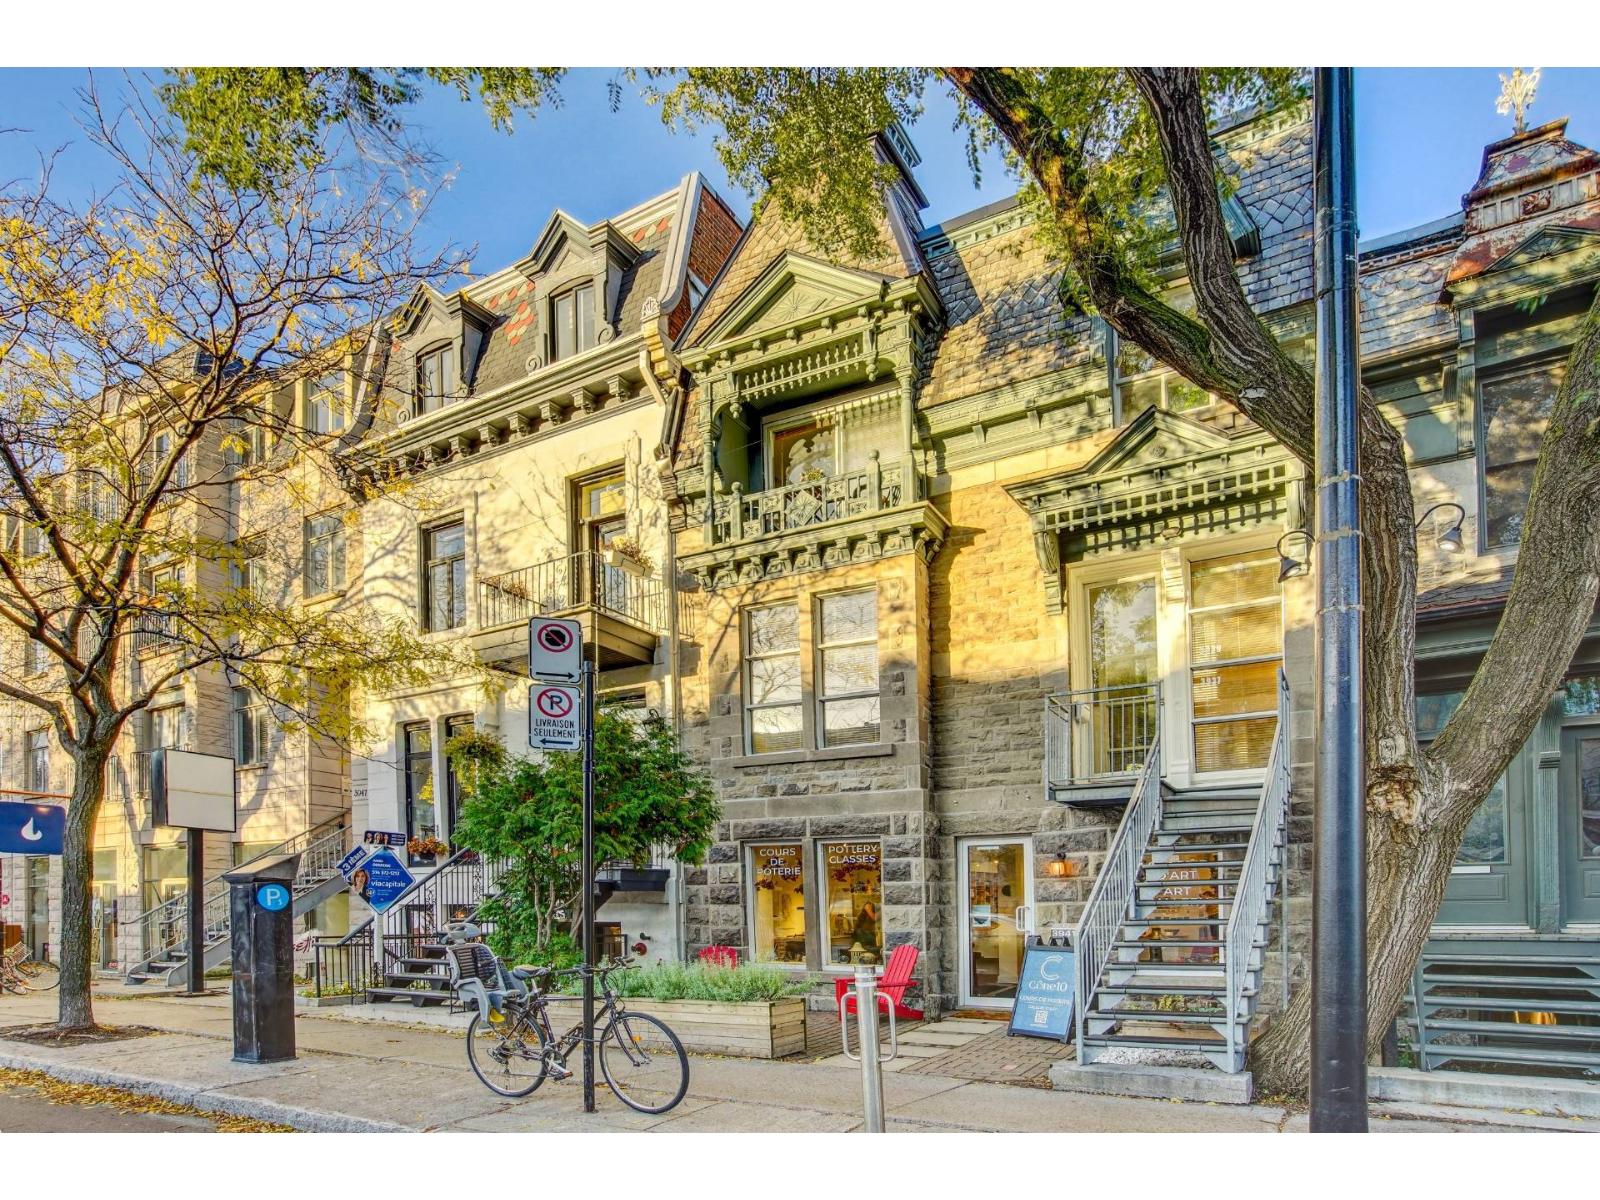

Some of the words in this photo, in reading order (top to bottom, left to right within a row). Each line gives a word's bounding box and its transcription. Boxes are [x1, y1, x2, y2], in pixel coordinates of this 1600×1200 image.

[535, 718, 575, 729] LIVRAISON
[533, 728, 576, 739] SEULEMENT
[759, 847, 796, 857] COURS
[828, 844, 879, 854] POTTERY
[770, 858, 784, 866] DE
[829, 854, 876, 864] CLASSES
[1163, 886, 1191, 896] ART
